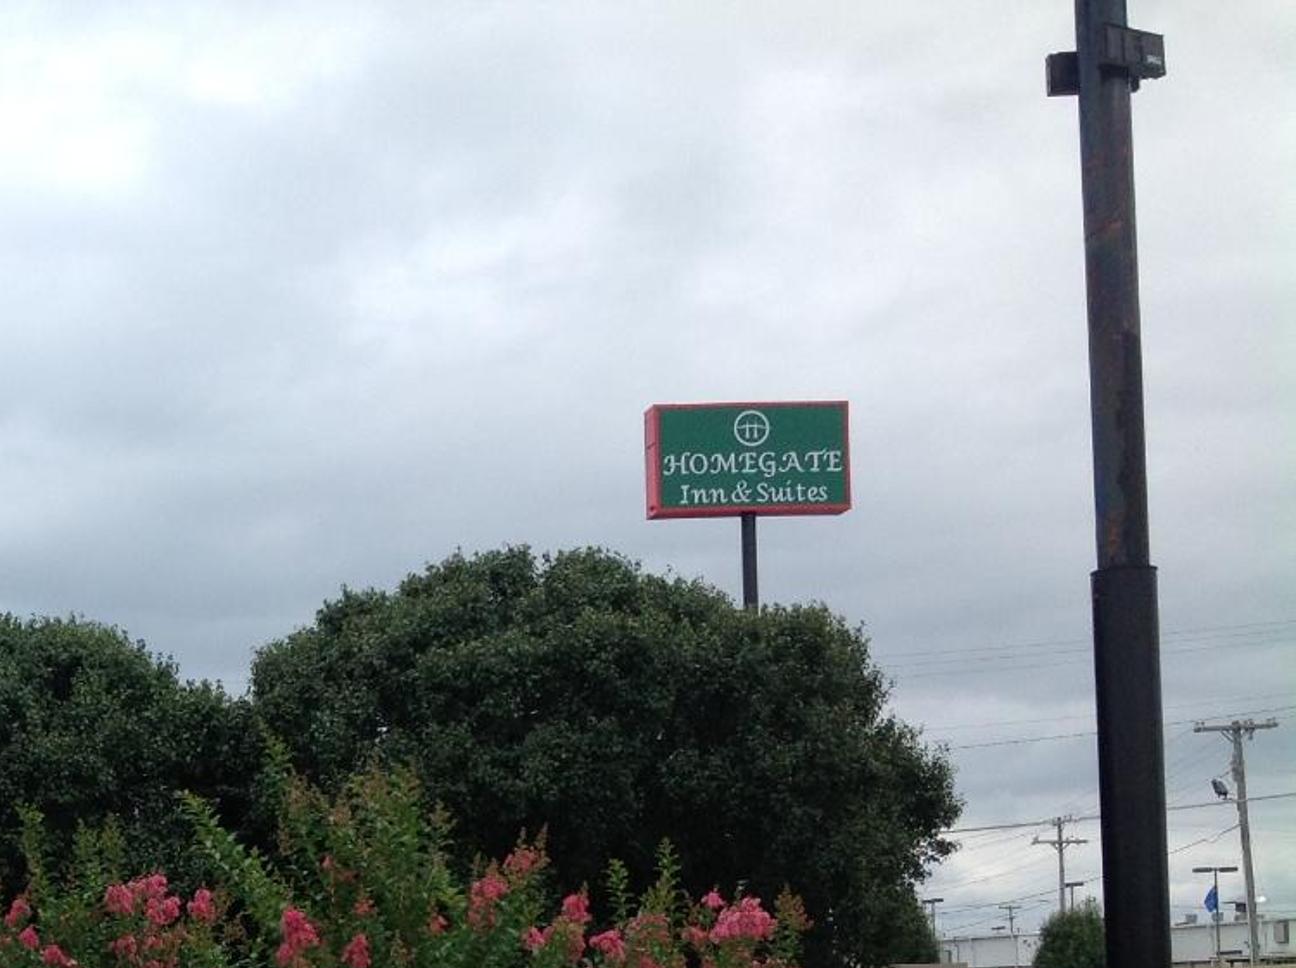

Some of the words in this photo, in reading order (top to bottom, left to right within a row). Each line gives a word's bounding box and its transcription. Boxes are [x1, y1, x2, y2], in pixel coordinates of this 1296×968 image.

[663, 450, 842, 477] HOMEGATE
[680, 484, 727, 504] Inn
[732, 480, 752, 502] &
[757, 480, 828, 502] Suites
